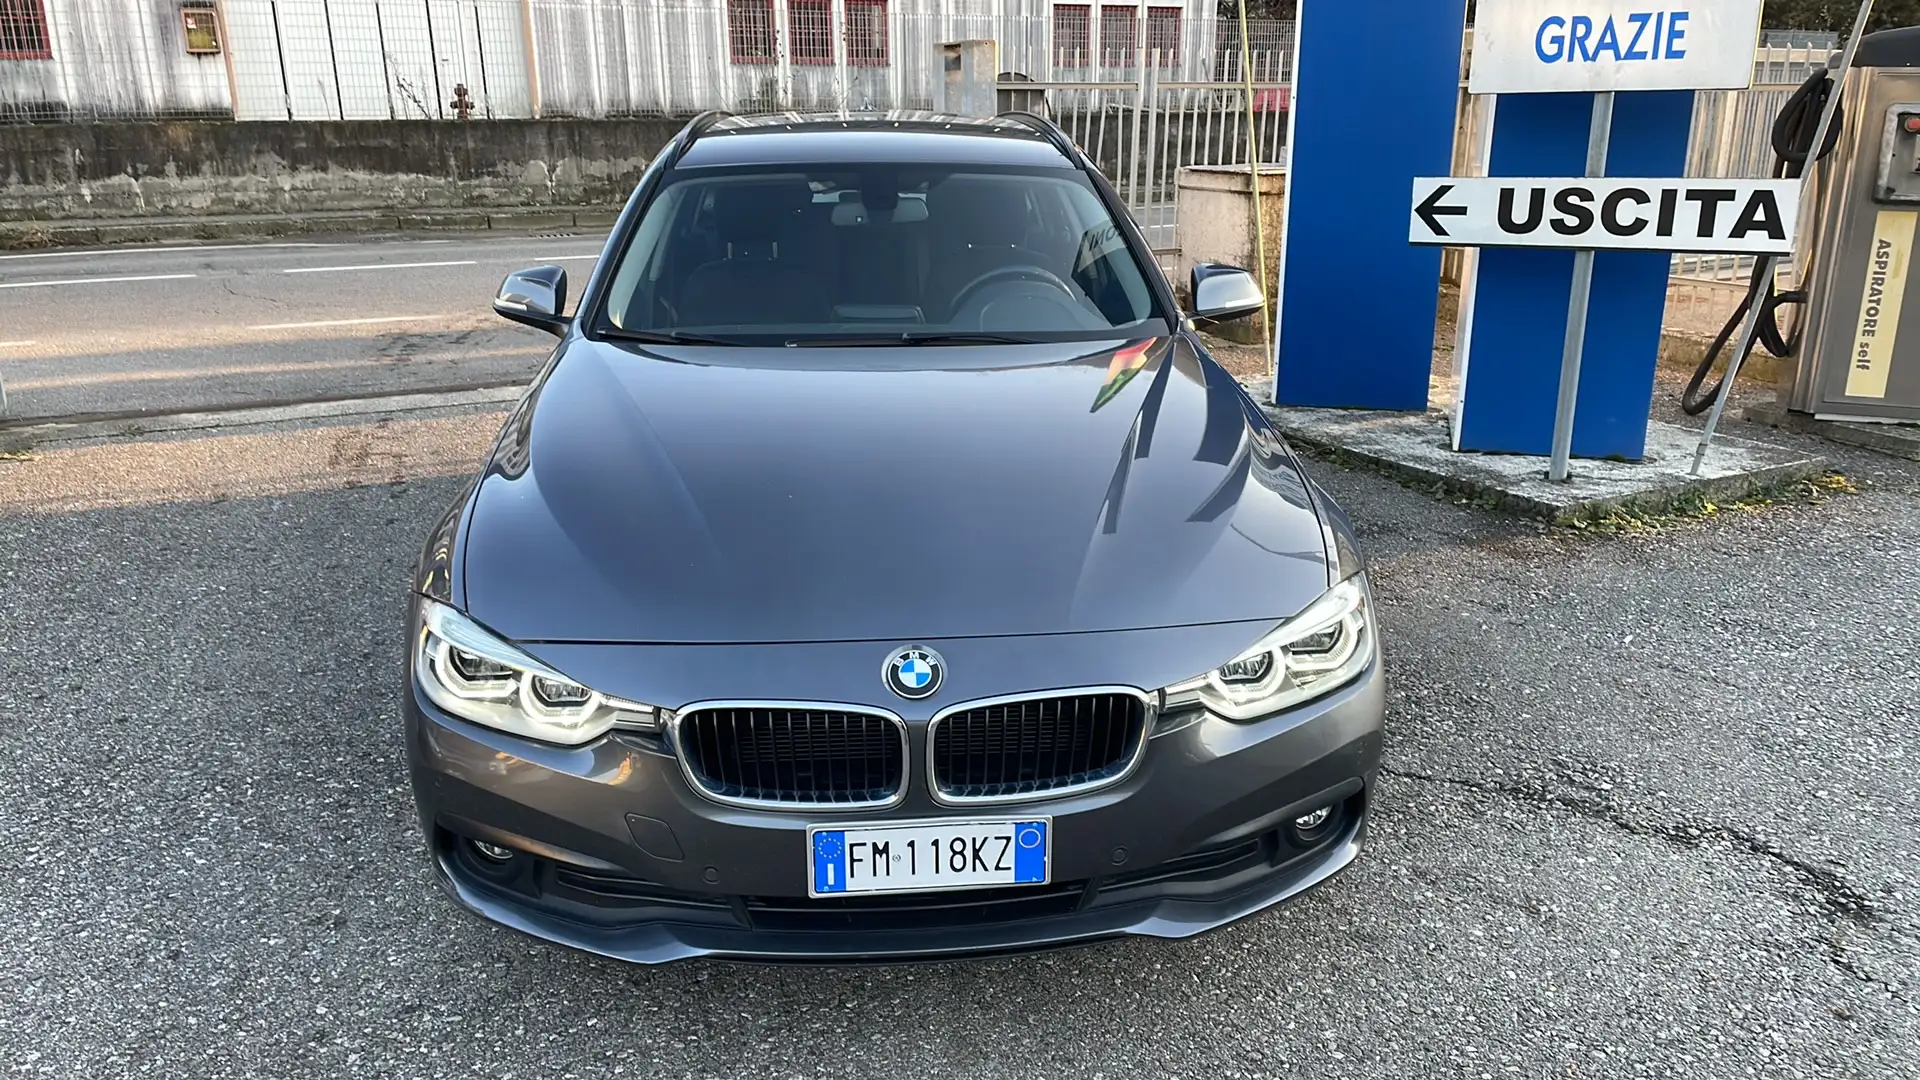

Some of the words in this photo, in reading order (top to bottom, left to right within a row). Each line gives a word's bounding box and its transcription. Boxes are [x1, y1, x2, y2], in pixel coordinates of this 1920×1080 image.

[1535, 11, 1690, 64] GRAZIE
[1496, 187, 1787, 240] USCITA
[1861, 238, 1892, 338] ASPIRATORE
[1855, 340, 1872, 371] self
[893, 651, 937, 666] BMW
